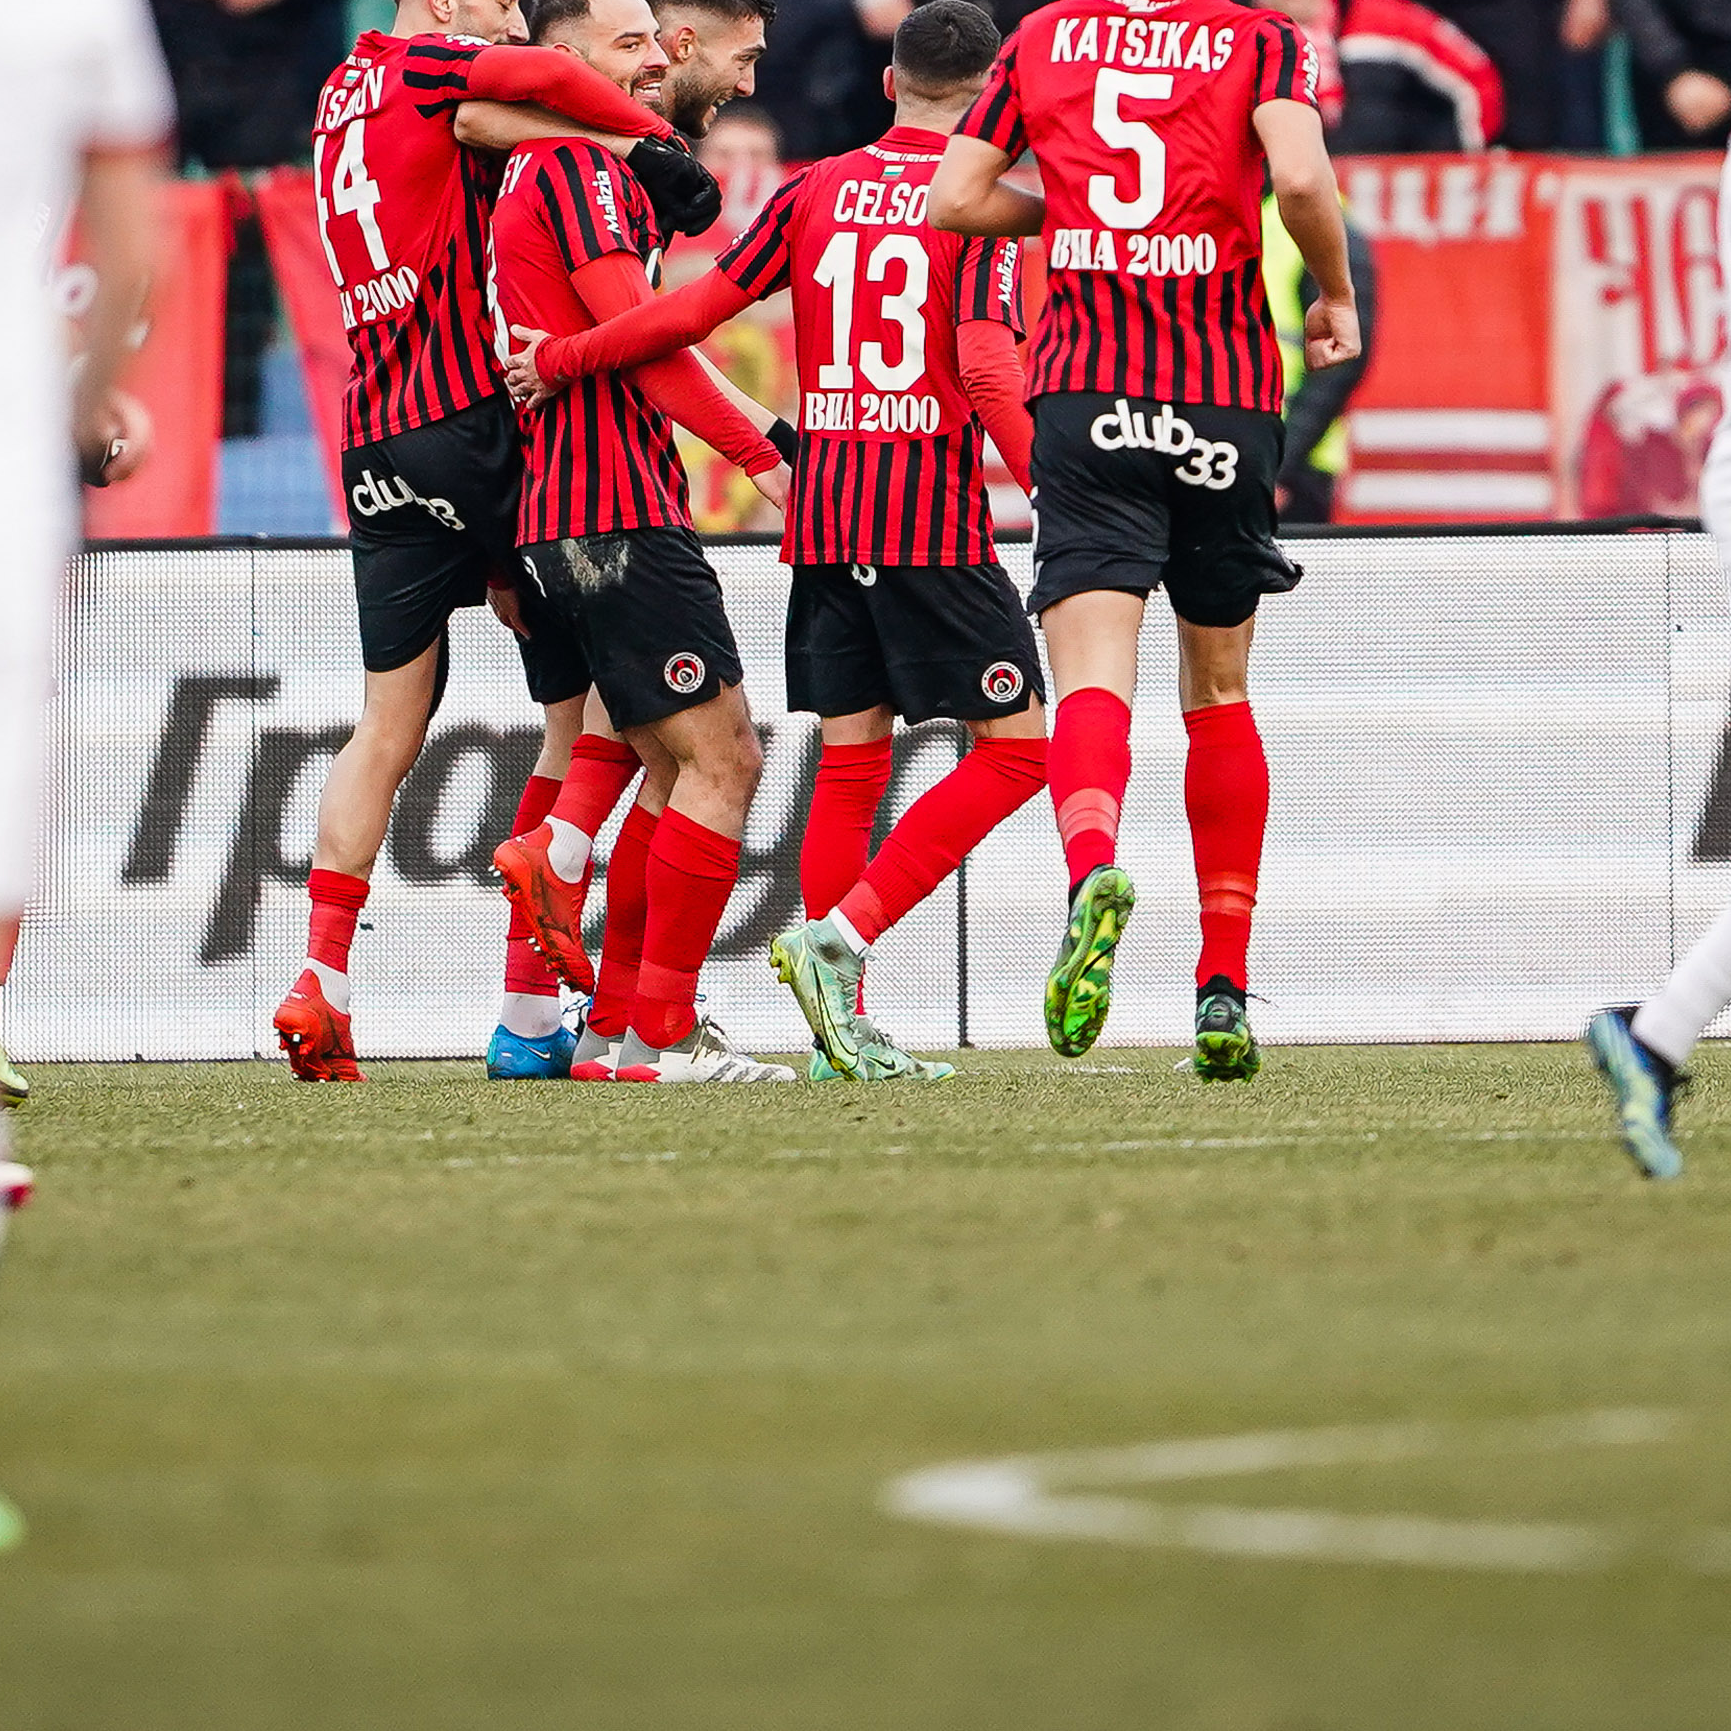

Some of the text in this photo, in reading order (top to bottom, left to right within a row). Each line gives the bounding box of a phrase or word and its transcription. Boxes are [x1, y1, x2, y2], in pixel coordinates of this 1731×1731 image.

[1050, 16, 1235, 73] KATSIKAS
[1088, 67, 1174, 229] 5
[591, 170, 622, 235] Malizia
[833, 179, 930, 227] CELSO
[996, 241, 1019, 307] Malizia
[1126, 233, 1217, 277] 2000
[354, 265, 419, 323] 2000
[813, 231, 930, 391] 13
[858, 392, 940, 434] 2000
